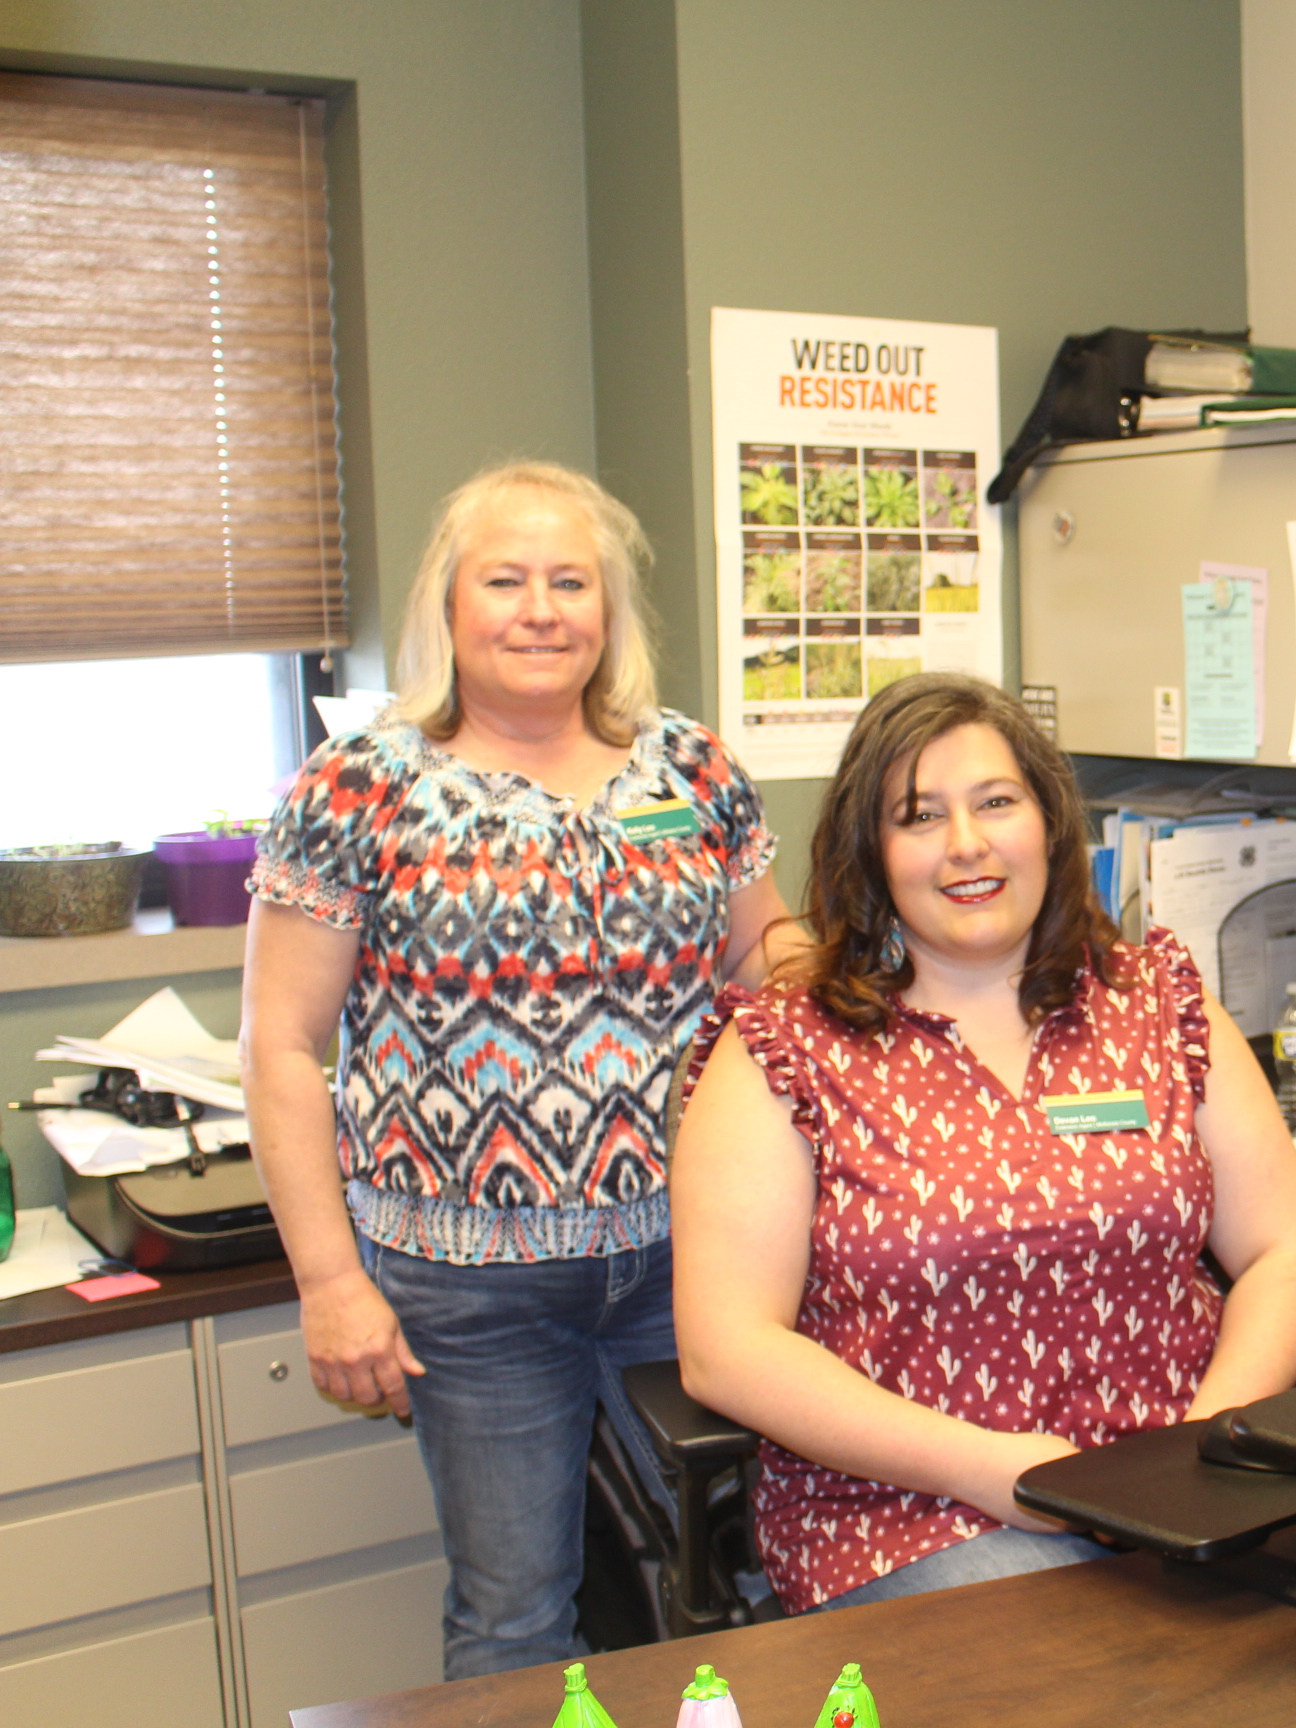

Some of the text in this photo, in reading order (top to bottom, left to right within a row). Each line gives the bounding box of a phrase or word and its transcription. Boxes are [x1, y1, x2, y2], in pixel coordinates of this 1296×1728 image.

[791, 338, 925, 377] WEED OUT
[779, 375, 938, 414] RESISTANCE
